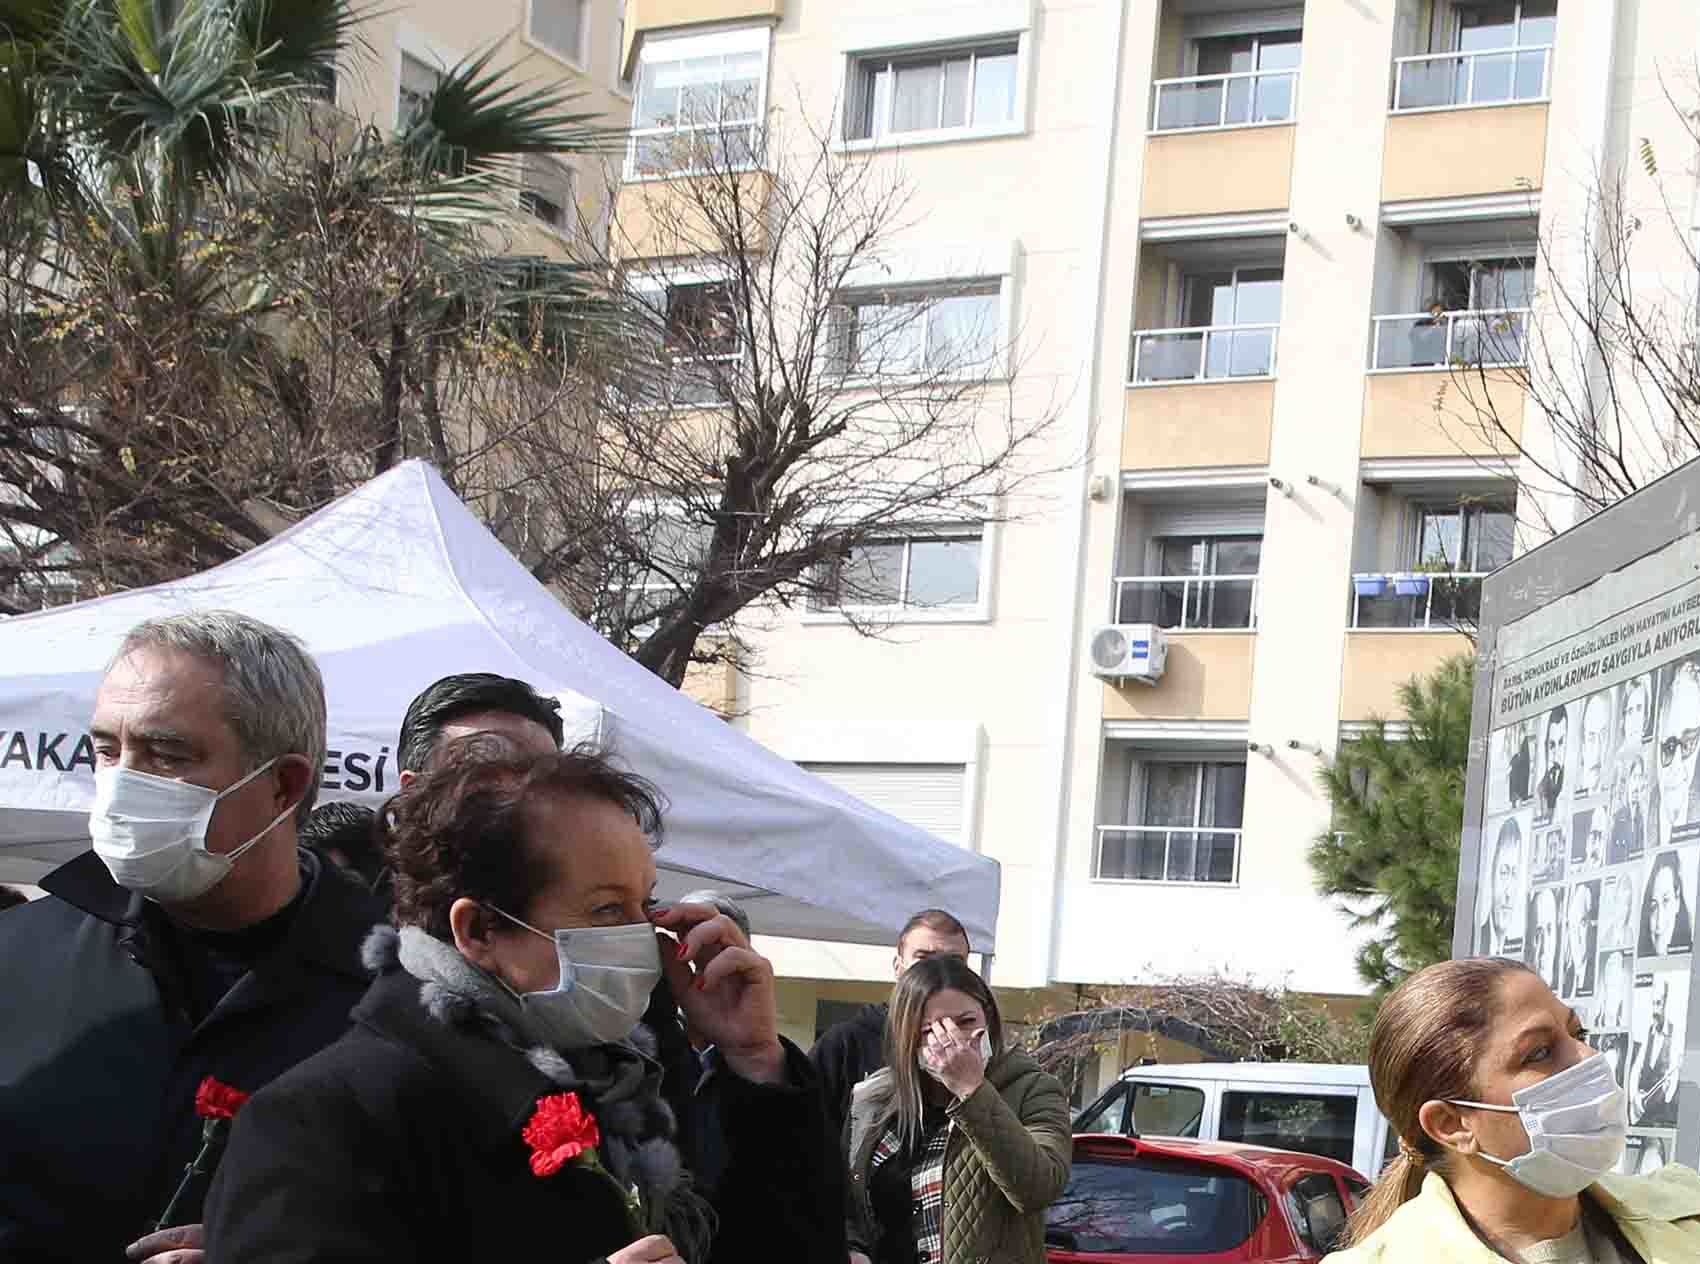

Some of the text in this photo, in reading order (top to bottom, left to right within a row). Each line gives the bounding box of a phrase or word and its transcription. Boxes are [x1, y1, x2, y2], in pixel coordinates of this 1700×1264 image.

[1501, 686, 1533, 714] BÜTÜN
[1533, 659, 1601, 702] AYDINLARIMIZI
[1601, 637, 1651, 674] SAYGIYLA
